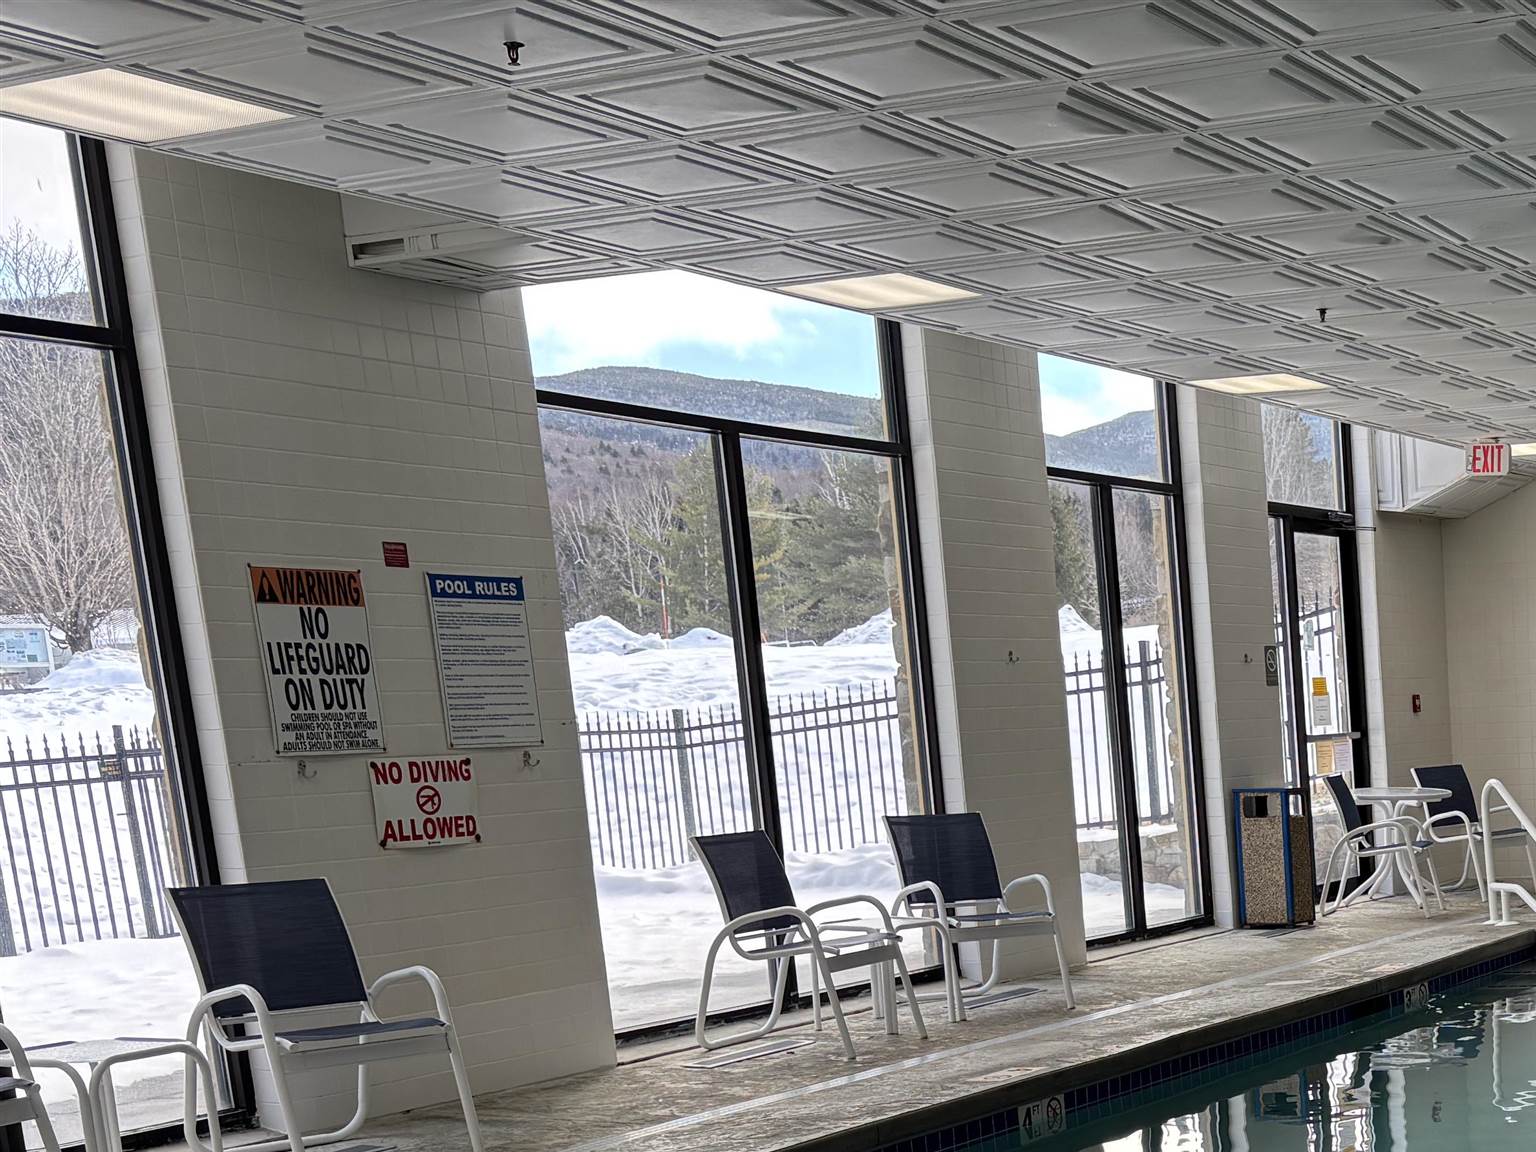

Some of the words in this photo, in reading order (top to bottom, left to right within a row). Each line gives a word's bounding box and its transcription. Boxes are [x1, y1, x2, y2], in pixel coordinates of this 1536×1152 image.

[1472, 445, 1504, 473] EXIT
[276, 570, 361, 606] WARNING
[435, 579, 472, 594] POOL
[474, 581, 518, 596] RULES
[299, 606, 329, 640] NO
[267, 642, 370, 675] LIFEGUARD
[284, 678, 316, 711] ON
[319, 678, 366, 711] DUTY
[281, 722, 315, 732] SWIMMING
[316, 722, 333, 731] POOL
[334, 722, 341, 731] OR
[343, 721, 353, 730] SPA
[354, 720, 378, 730] WITHOUT
[291, 713, 319, 722] CHILDREN
[320, 712, 344, 721] SHOULD
[345, 712, 357, 721] NOT
[358, 711, 368, 720] USE
[283, 741, 307, 751] ADULTS
[308, 741, 332, 751] SHOULD
[333, 740, 345, 750] NOT
[295, 732, 305, 741] AN
[306, 731, 324, 741] ADULT
[325, 731, 333, 740] IN
[372, 761, 403, 785] NO
[407, 759, 471, 783] DIVING
[383, 815, 477, 842] ALLOWED
